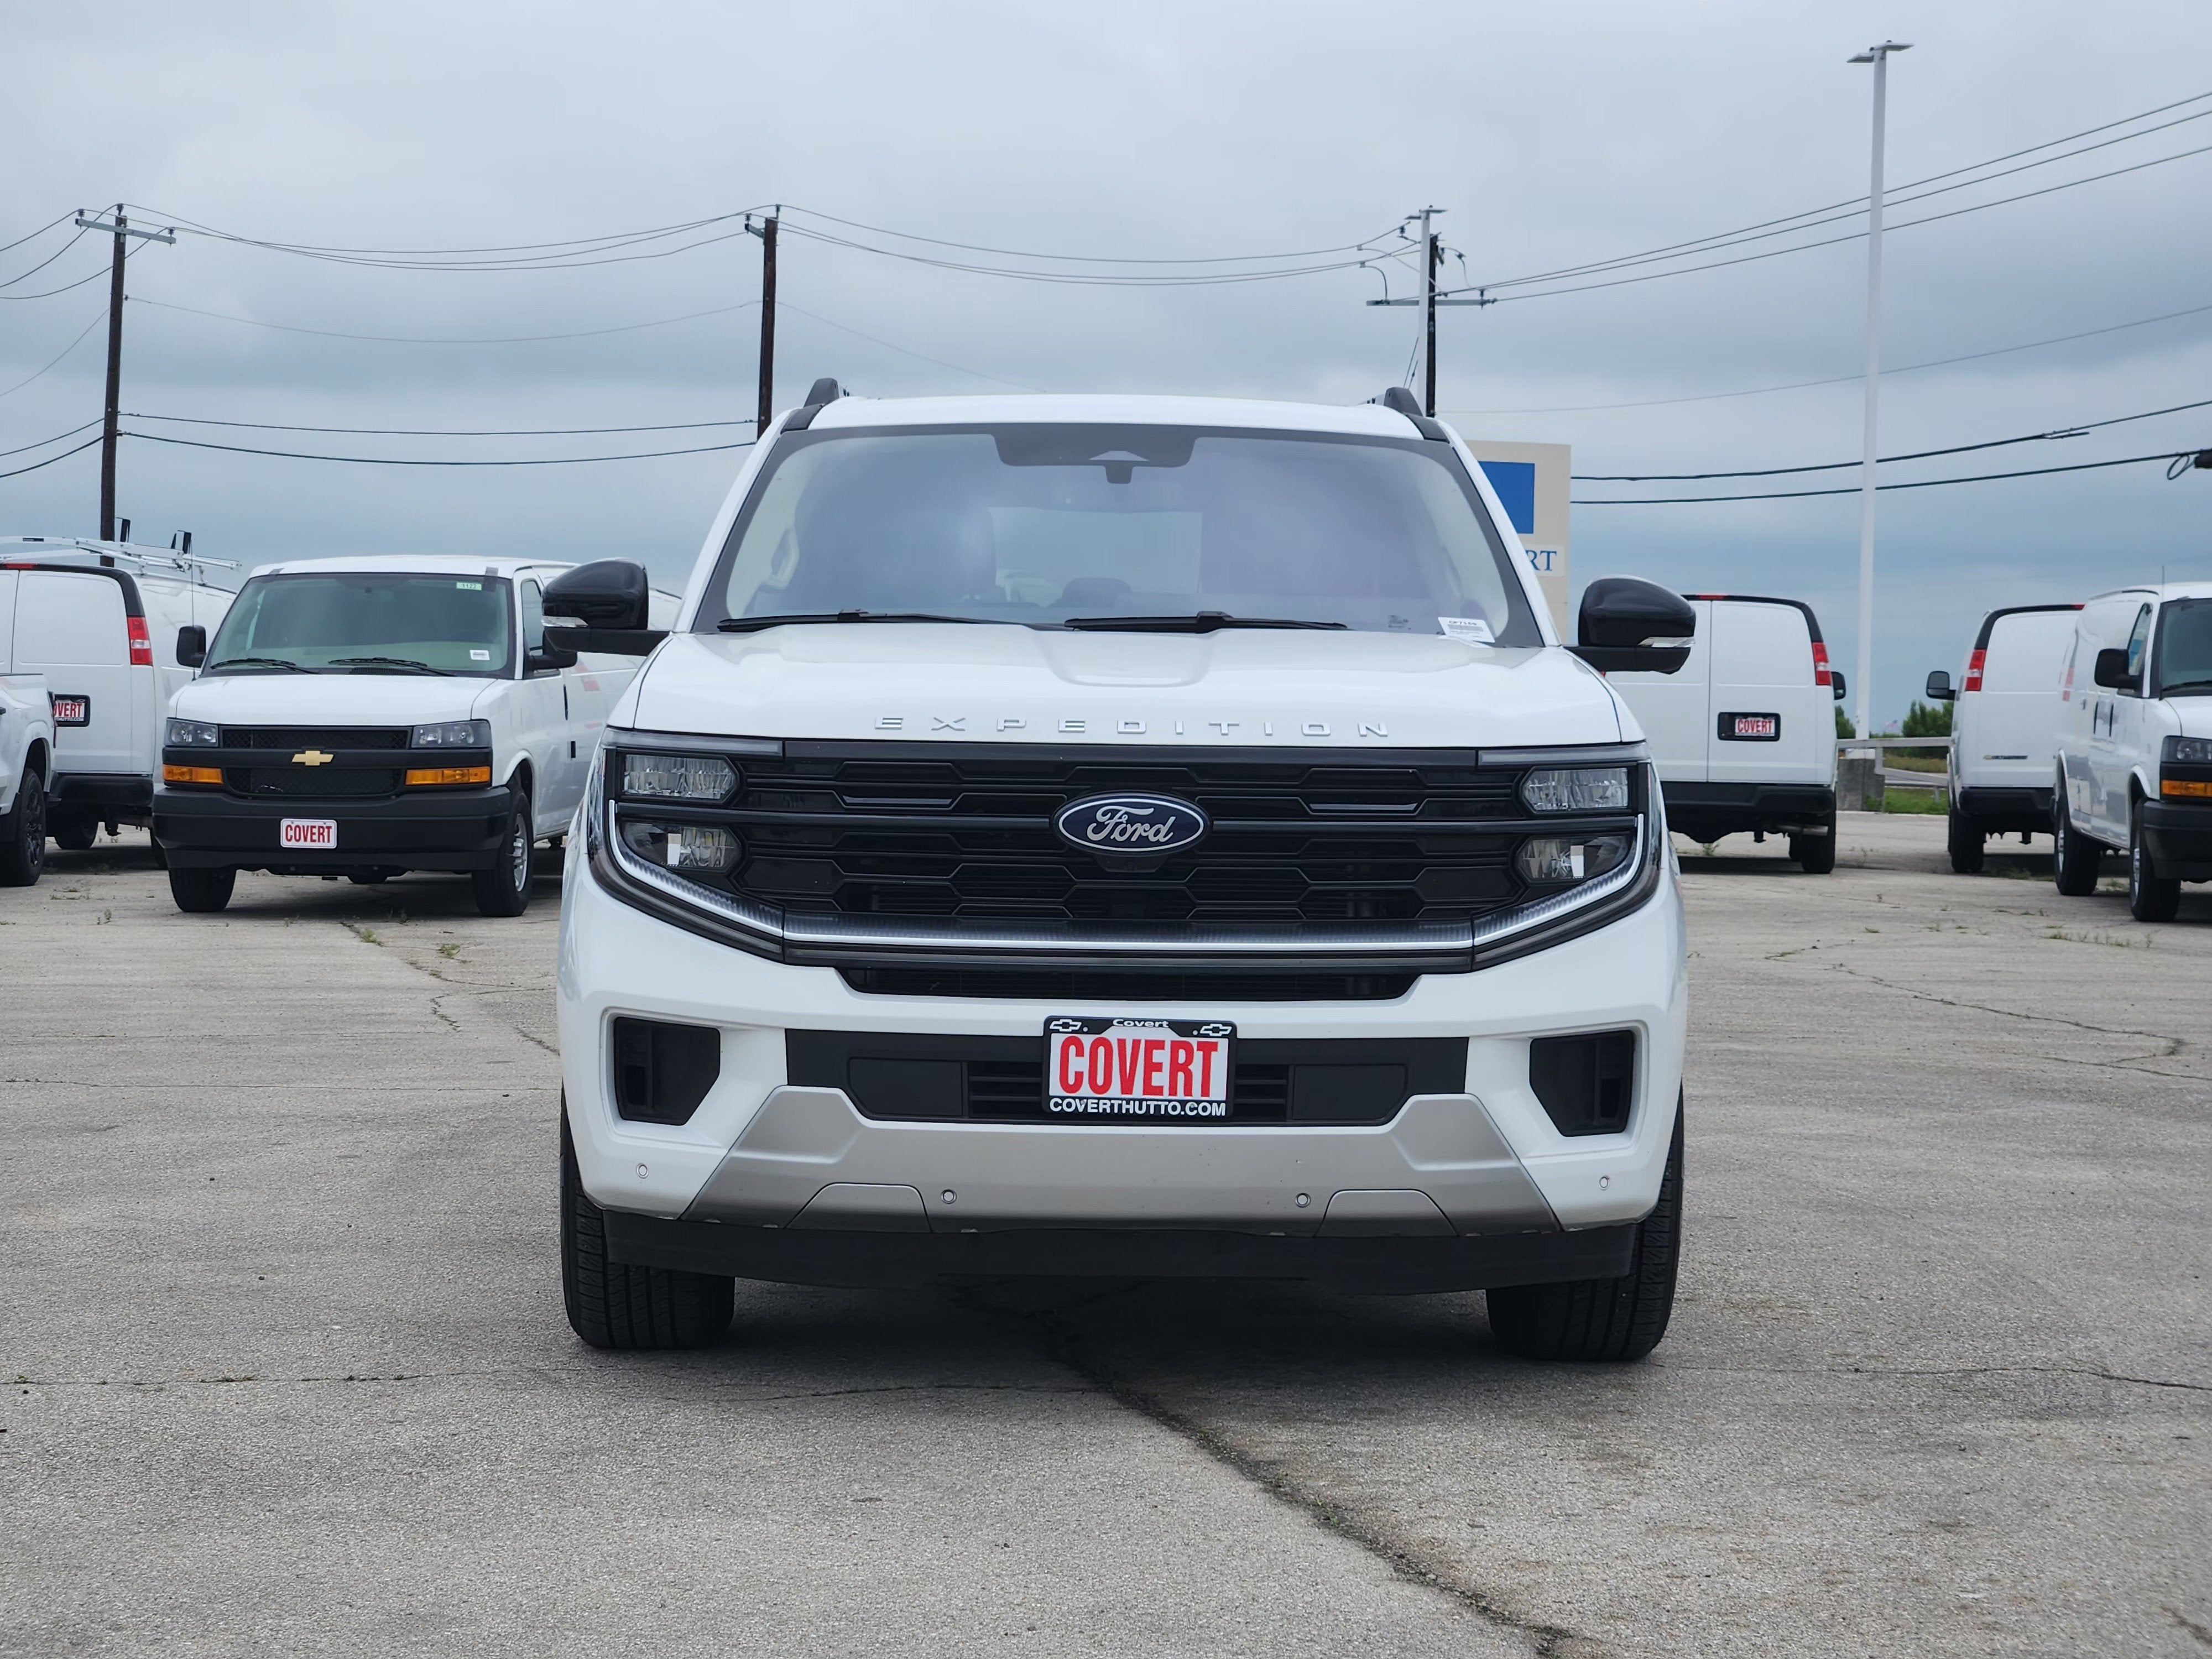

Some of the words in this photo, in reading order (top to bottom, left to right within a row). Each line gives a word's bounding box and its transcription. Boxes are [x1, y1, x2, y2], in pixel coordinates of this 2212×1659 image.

[874, 717, 1387, 737] EXPEDITION
[1738, 719, 1772, 733] COVERT
[1087, 806, 1176, 842] Ford
[285, 825, 332, 843] COVERT
[1113, 1019, 1169, 1028] Covert
[1059, 1036, 1219, 1097] COVERT
[1050, 1098, 1226, 1116] COVERTHUTTO.COM
